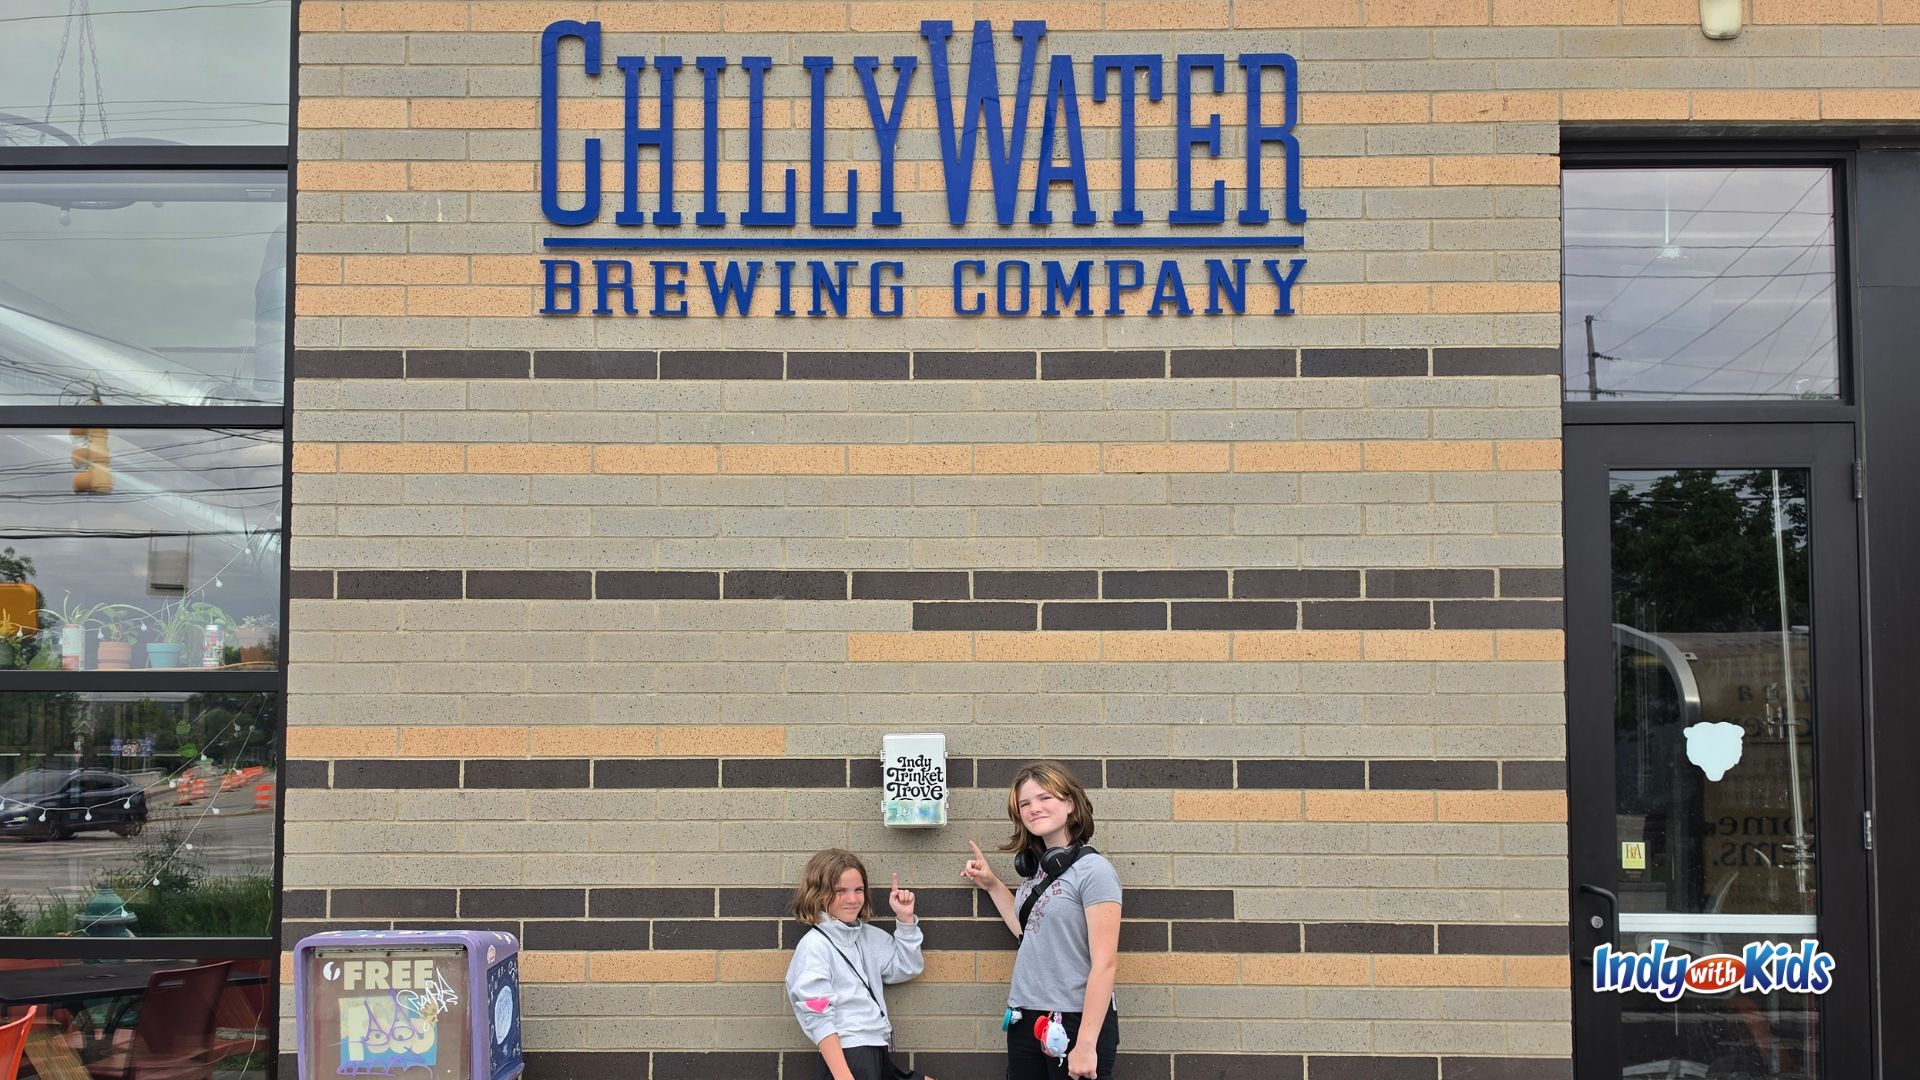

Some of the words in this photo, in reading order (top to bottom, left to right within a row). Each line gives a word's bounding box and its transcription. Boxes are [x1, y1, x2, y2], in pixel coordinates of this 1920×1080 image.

[539, 259, 905, 316] BREWING
[953, 259, 1308, 317] COMPANY
[897, 754, 932, 772] Indy
[887, 766, 943, 786] Trinket
[887, 782, 943, 800] Trove
[344, 960, 433, 990] FREE
